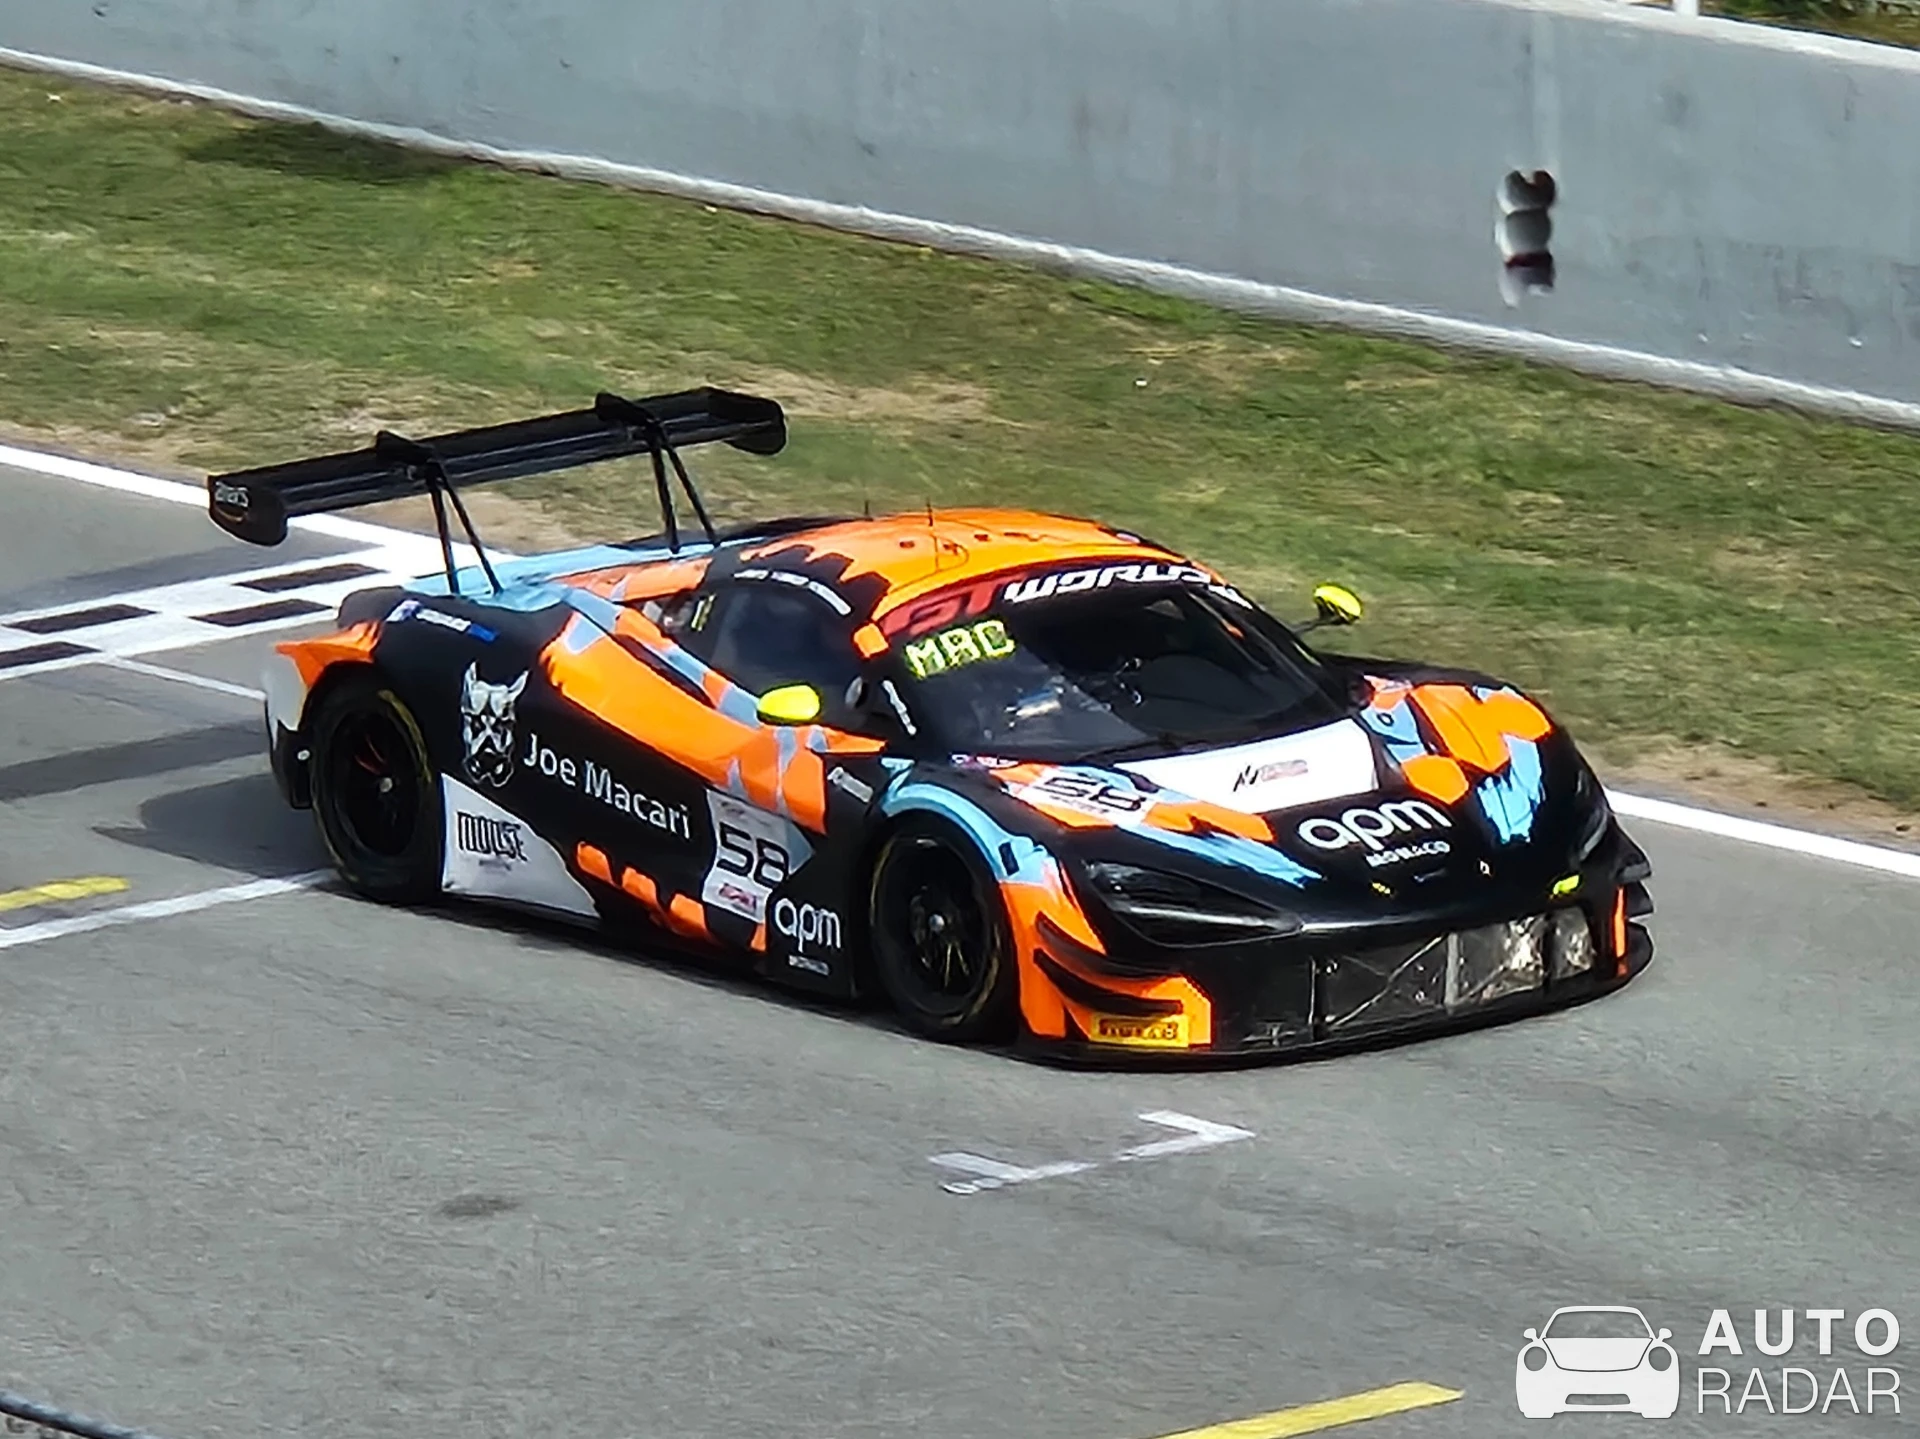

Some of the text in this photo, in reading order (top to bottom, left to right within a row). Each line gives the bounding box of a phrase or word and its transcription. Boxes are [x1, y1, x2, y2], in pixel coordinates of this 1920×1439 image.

[523, 733, 577, 787] Joe
[584, 759, 690, 840] Macari
[716, 821, 790, 890] 58
[1298, 799, 1452, 851] apm
[774, 897, 842, 954] apm
